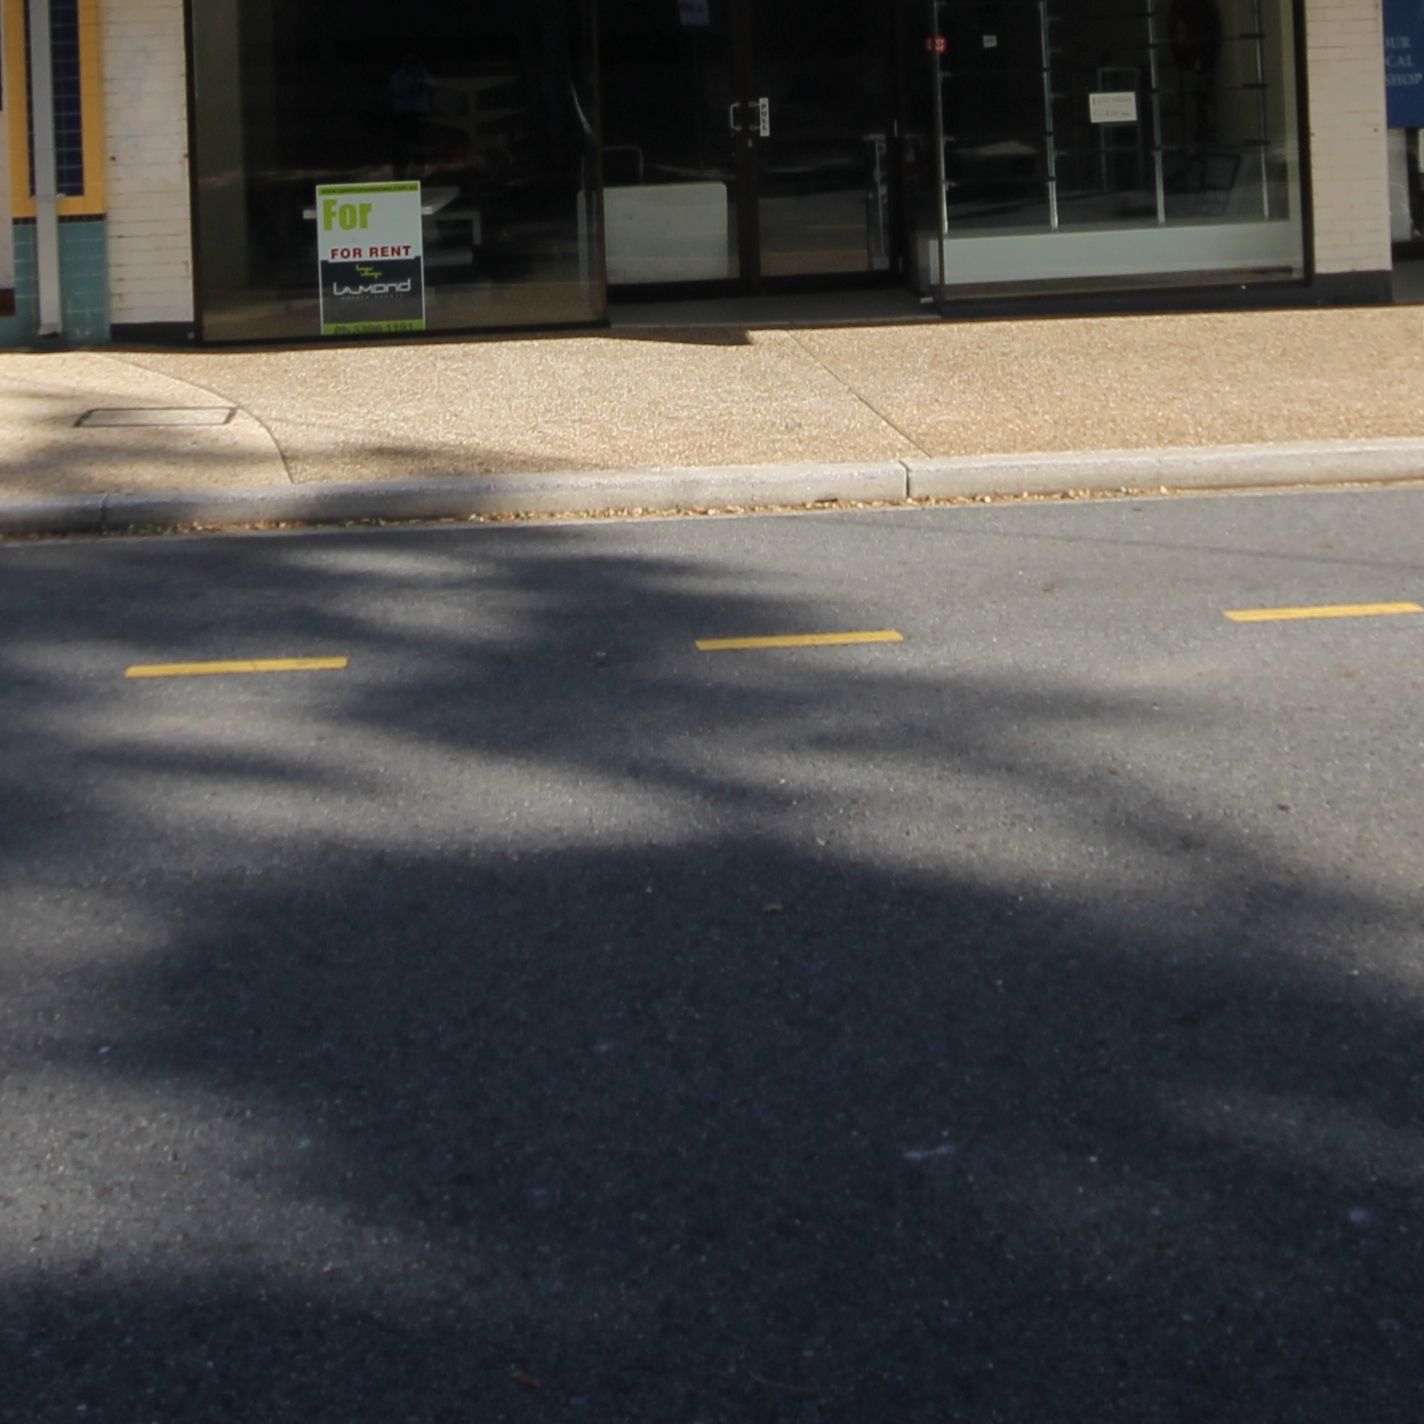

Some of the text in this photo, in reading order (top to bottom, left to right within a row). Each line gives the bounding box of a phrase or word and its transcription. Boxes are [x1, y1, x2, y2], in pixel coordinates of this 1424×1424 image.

[322, 198, 373, 232] For
[331, 244, 412, 260] FOR RENT
